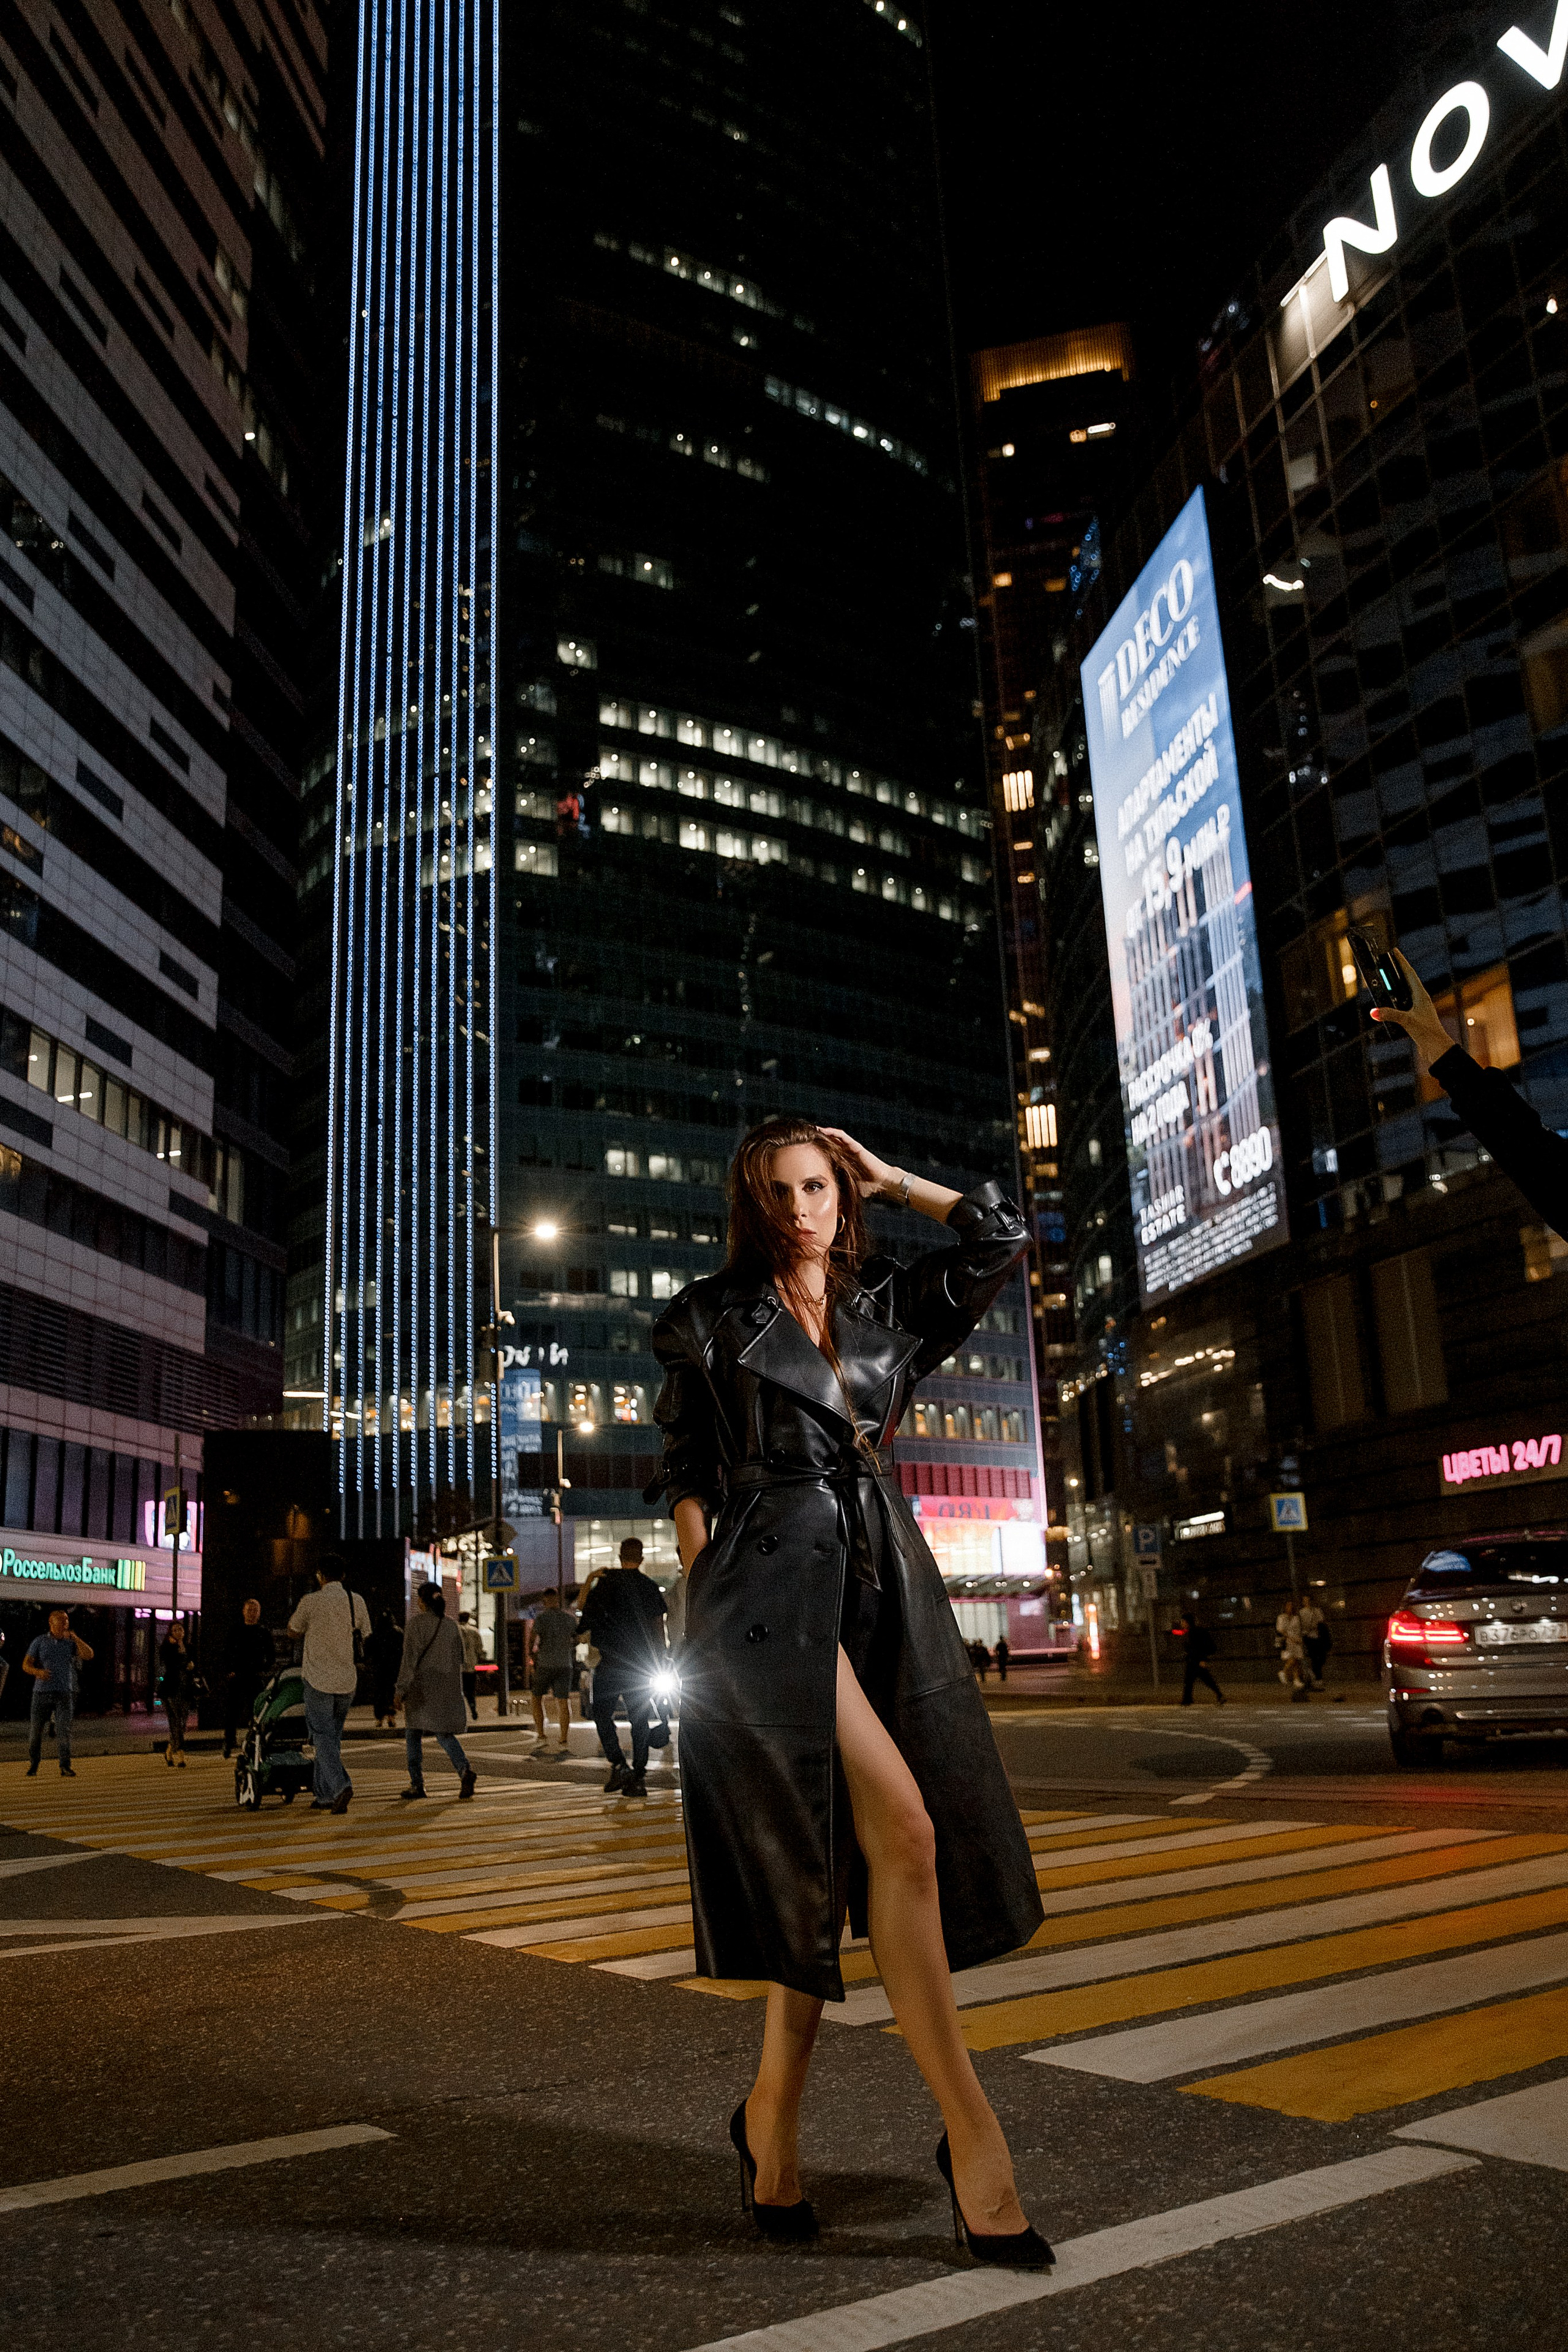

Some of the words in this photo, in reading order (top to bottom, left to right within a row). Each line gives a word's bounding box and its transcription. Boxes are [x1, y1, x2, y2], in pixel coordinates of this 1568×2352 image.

[1116, 559, 1194, 701] DECO
[1121, 614, 1200, 739] RESIDENCE
[1118, 692, 1219, 840] АПАРТАМЕНТЫ
[1229, 1126, 1273, 1189] 8890
[1141, 1204, 1186, 1246] ESTATE
[1442, 1444, 1510, 1485] ЦВЕТЫ
[1512, 1434, 1562, 1471] 24/7
[2, 1548, 116, 1586] РоссельхозБанк
